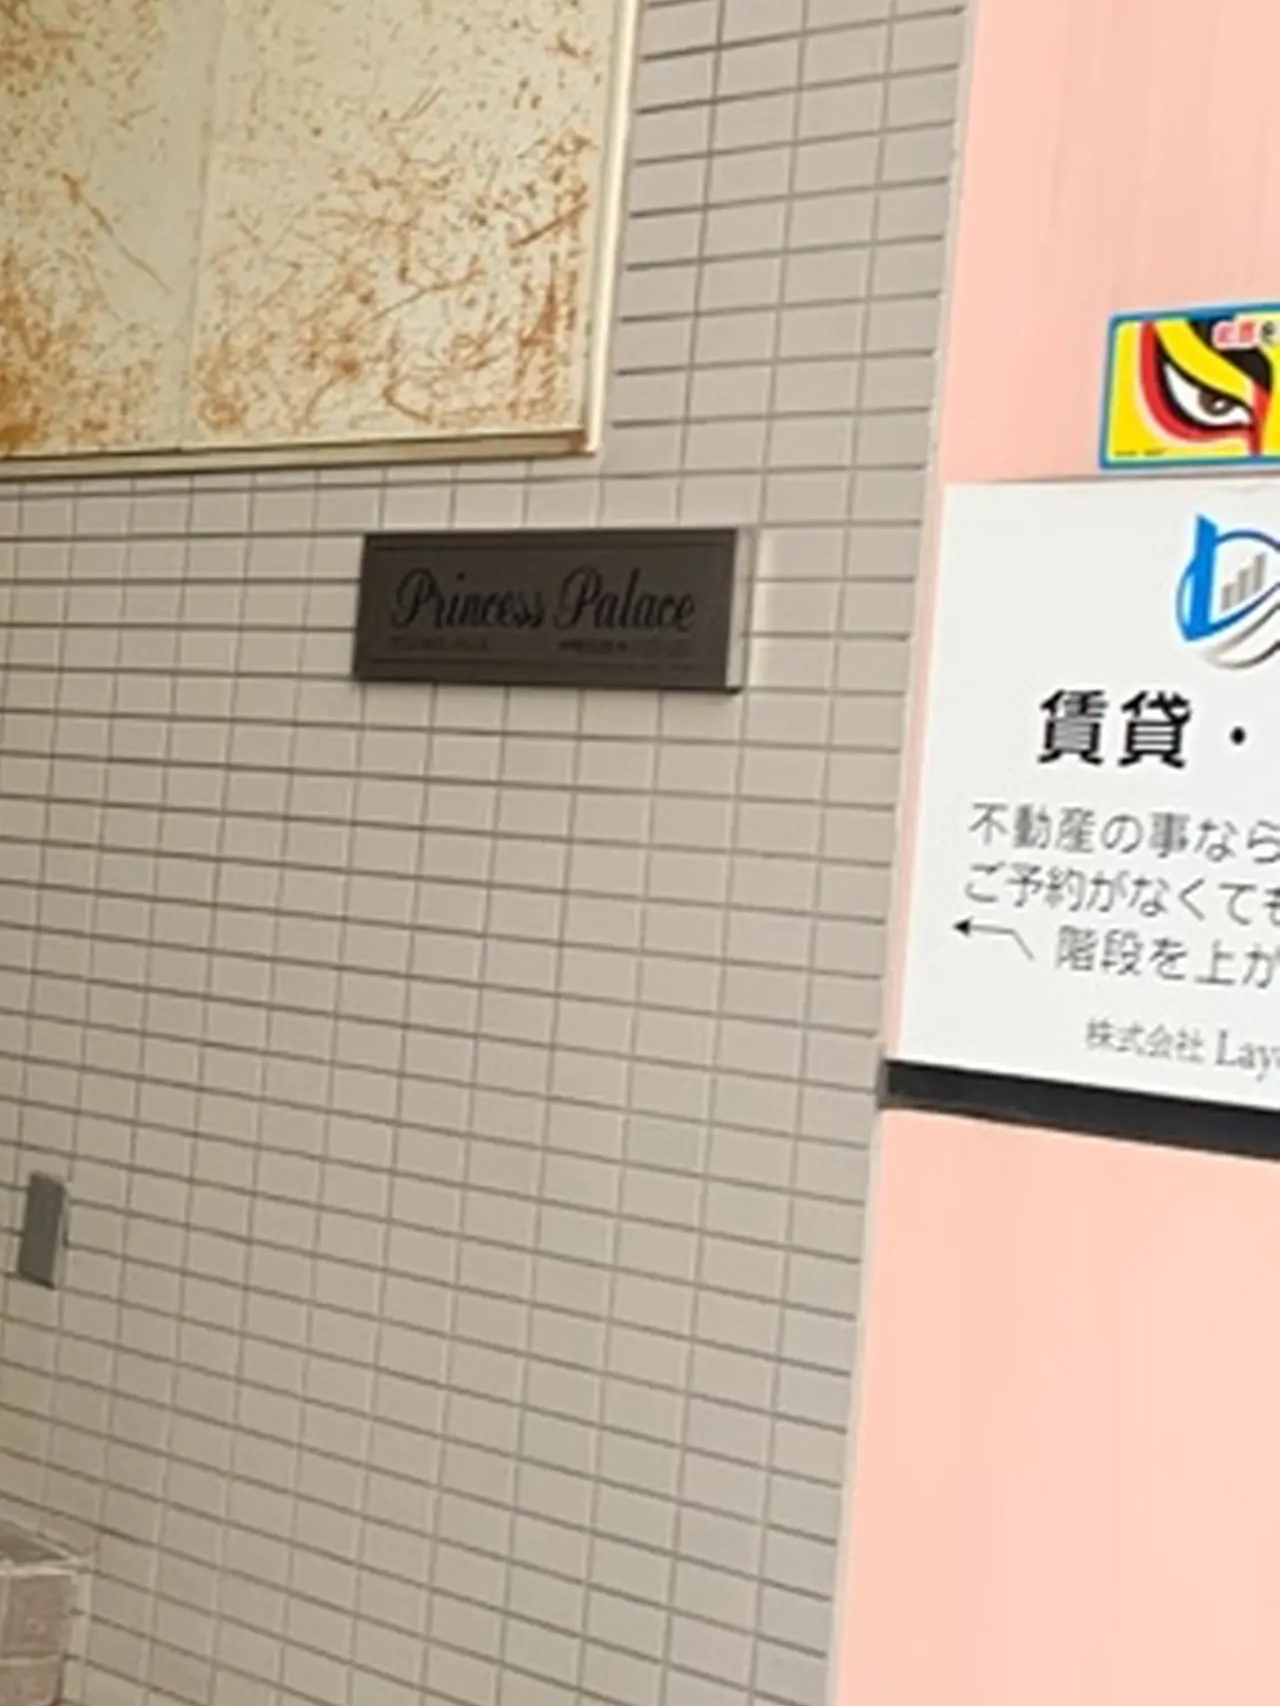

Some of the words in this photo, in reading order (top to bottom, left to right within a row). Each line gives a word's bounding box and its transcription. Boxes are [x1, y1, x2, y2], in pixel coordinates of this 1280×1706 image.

[390, 566, 546, 631] Princess
[552, 564, 696, 632] Palace
[968, 801, 1280, 865] 不動産の事なら
[1086, 1019, 1206, 1064] 株式会社
